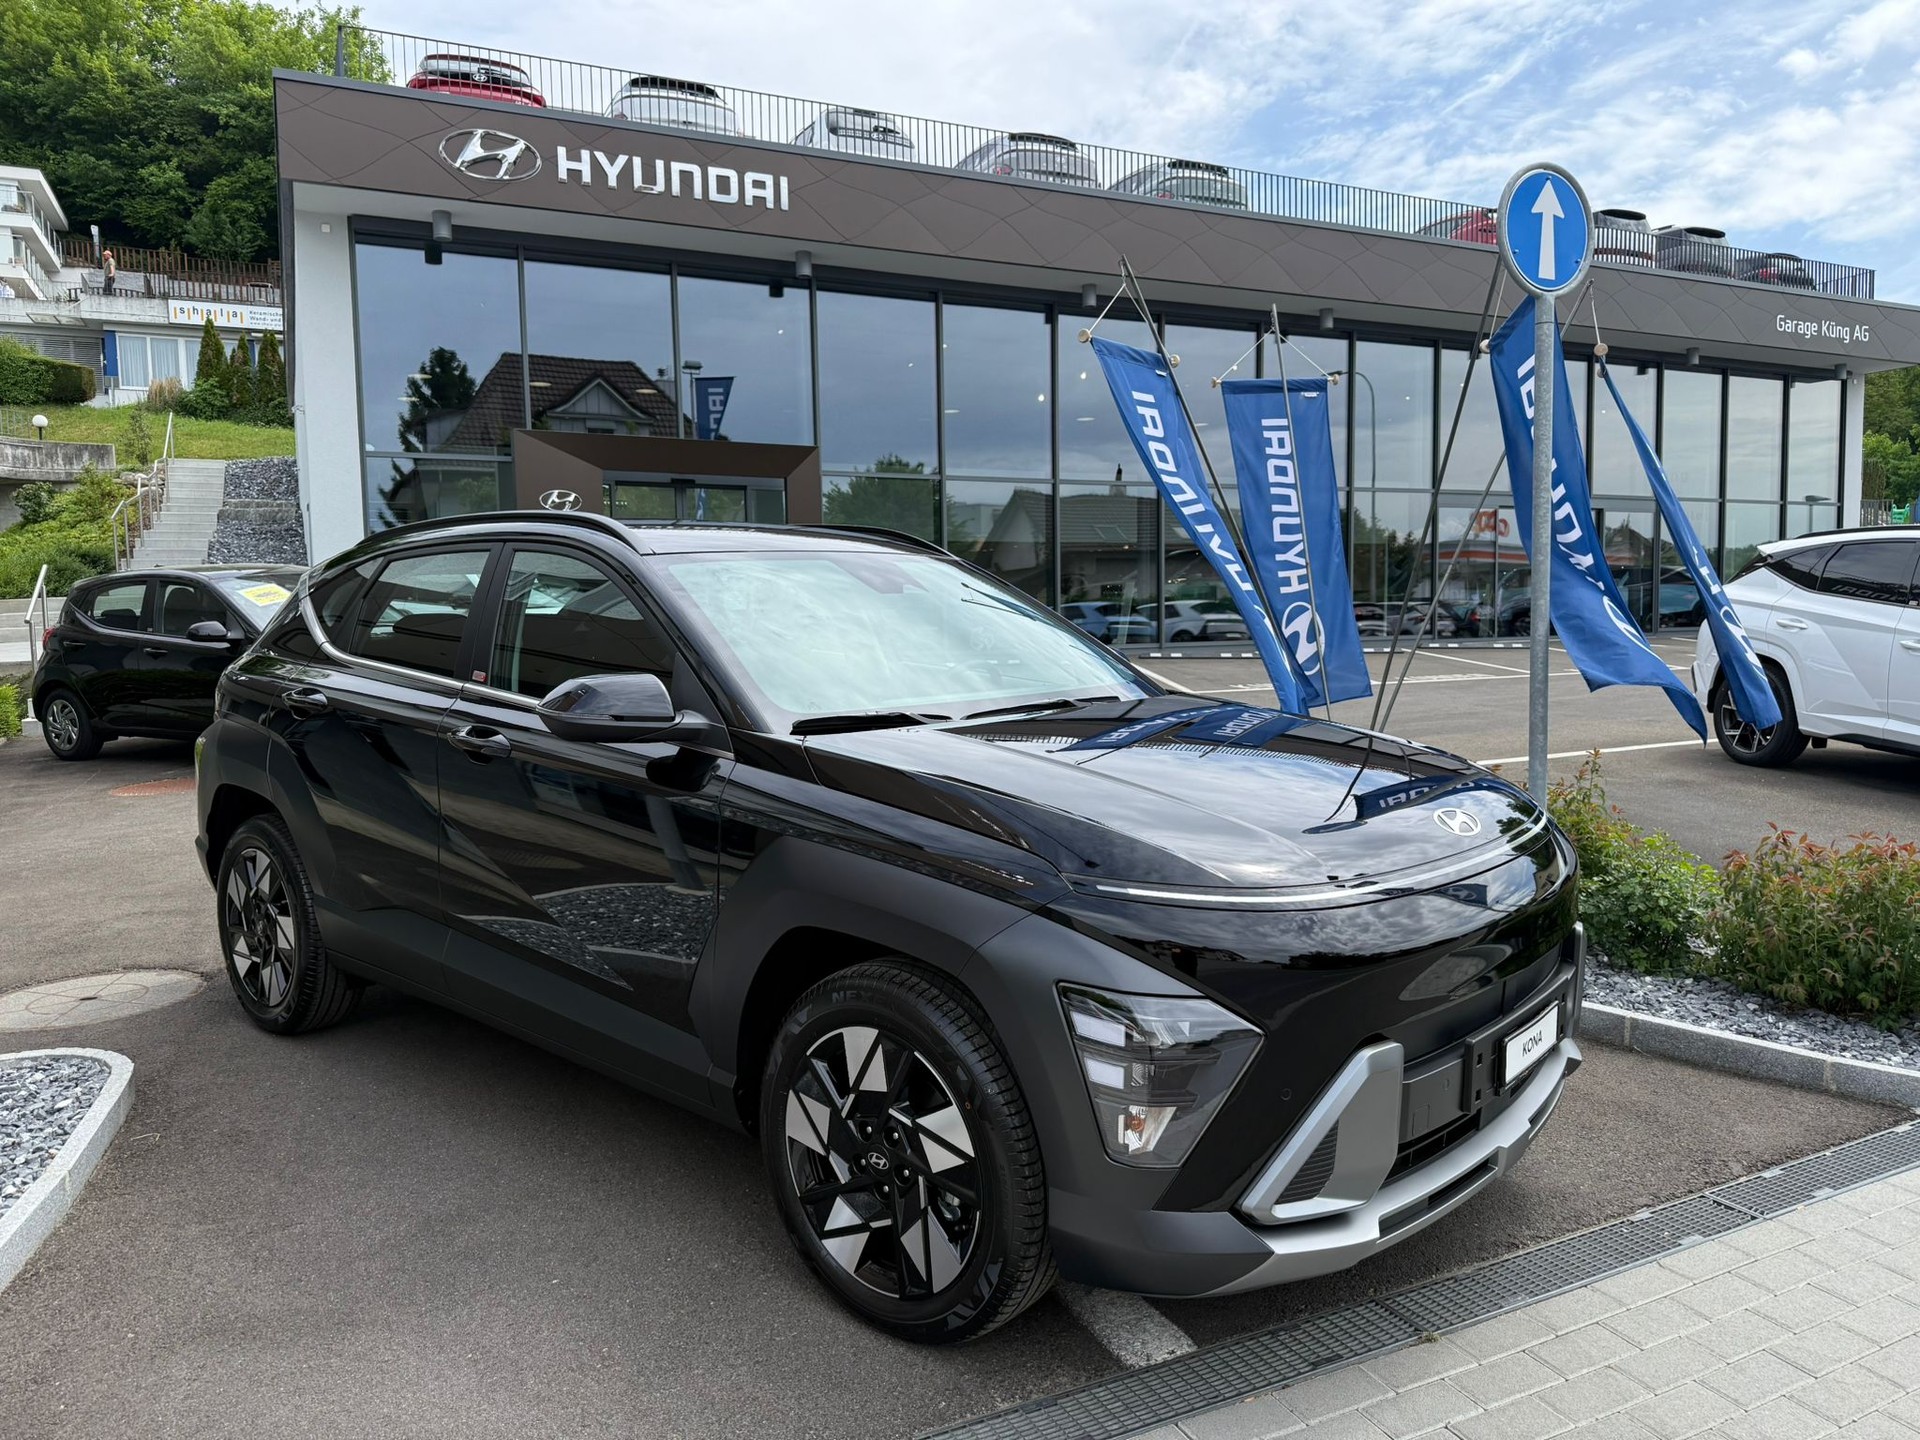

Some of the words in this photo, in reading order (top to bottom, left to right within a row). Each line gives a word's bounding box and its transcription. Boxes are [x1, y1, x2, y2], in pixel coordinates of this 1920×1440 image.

[557, 146, 789, 211] HYUNDAI
[1776, 314, 1818, 338] Garage
[1821, 320, 1850, 343] Küng
[1853, 324, 1869, 341] AG
[1522, 1030, 1543, 1057] KONA
